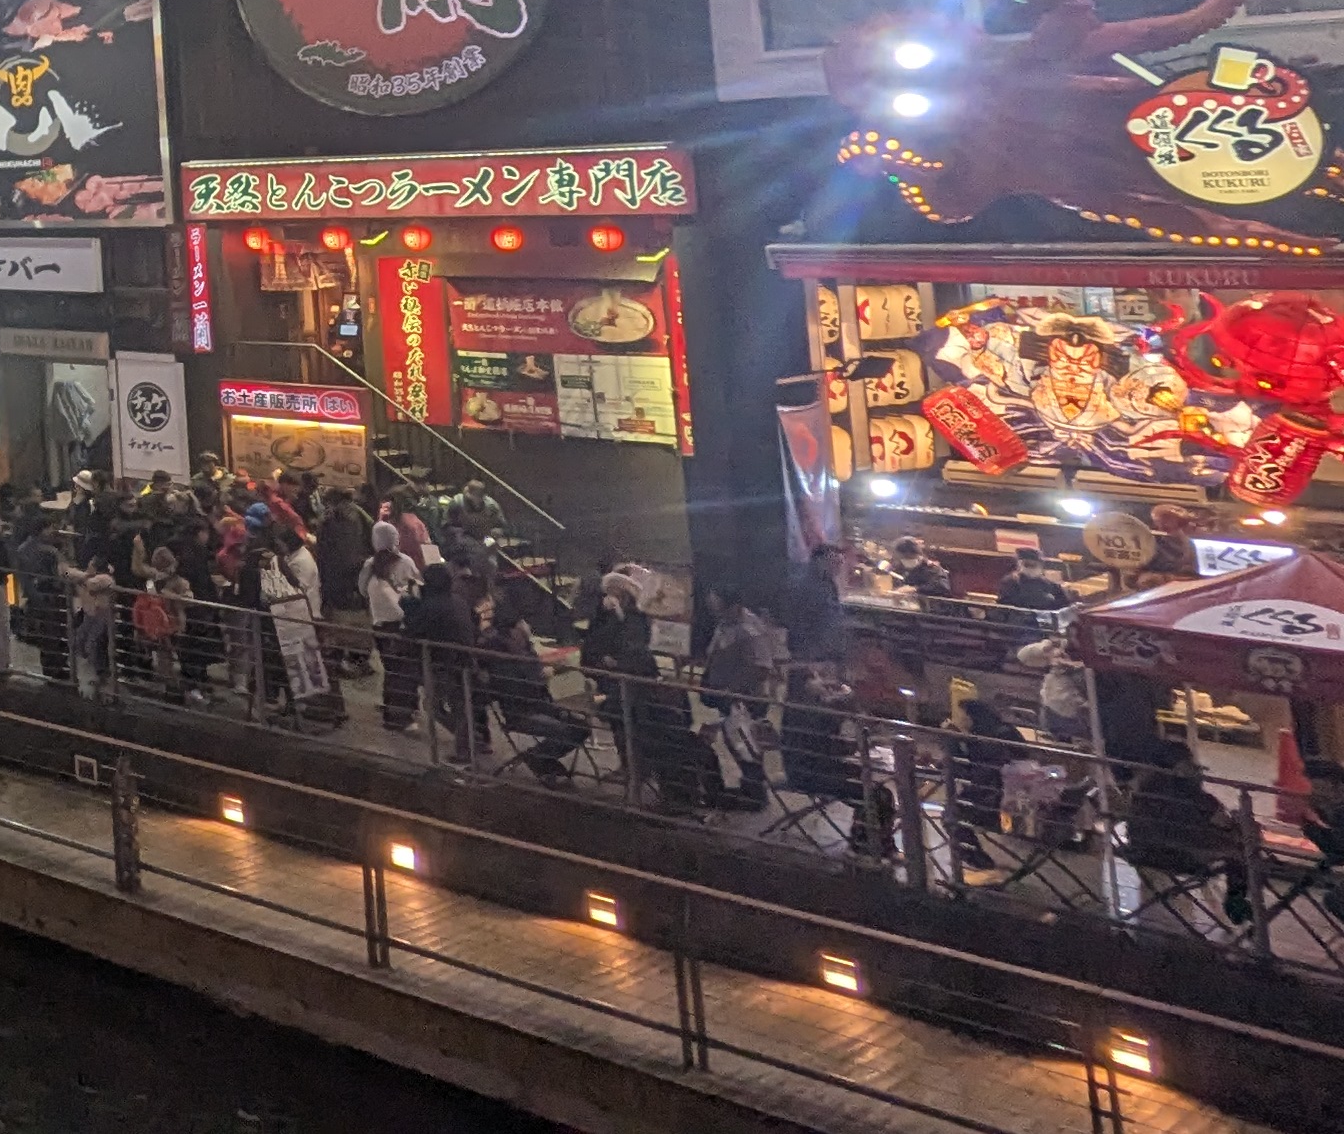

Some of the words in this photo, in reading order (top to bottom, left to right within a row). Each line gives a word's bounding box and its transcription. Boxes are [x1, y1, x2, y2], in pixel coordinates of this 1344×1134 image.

[347, 45, 487, 97] 昭和35年創業
[1174, 107, 1285, 162] くくる
[188, 157, 689, 215] 天然とんこつラーメン専門店
[1202, 178, 1271, 189] KUKURU
[189, 227, 212, 353] ラーメン一蘭
[1148, 269, 1261, 286] KUKURU
[220, 389, 319, 414] お土産販売所
[324, 396, 354, 414] はい
[1241, 607, 1325, 635] くくる
